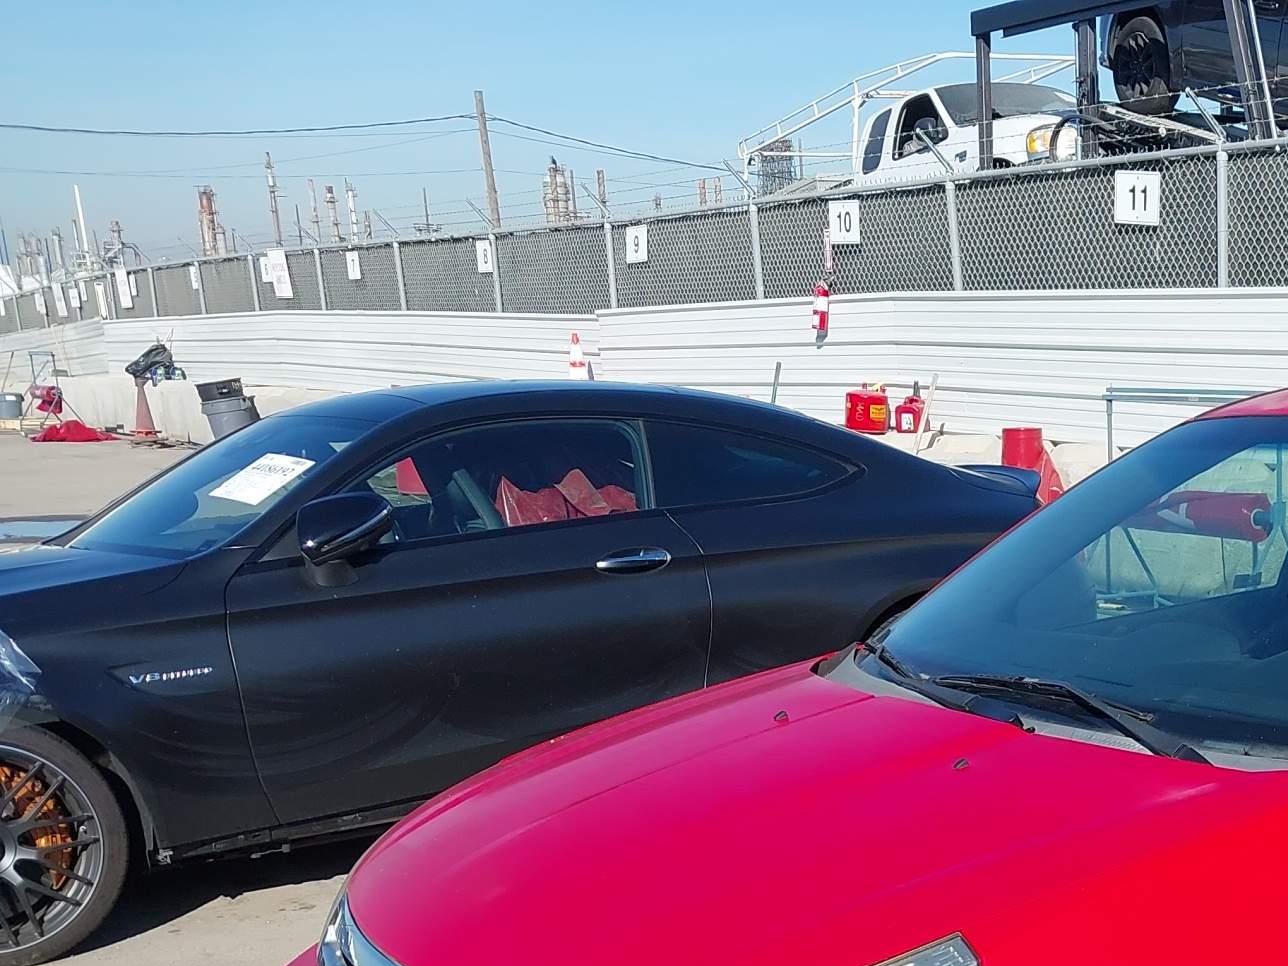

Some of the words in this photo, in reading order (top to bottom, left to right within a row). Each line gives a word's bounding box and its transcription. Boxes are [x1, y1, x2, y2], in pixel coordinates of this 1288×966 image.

[1128, 184, 1147, 211] 11
[837, 211, 851, 233] 10
[633, 235, 640, 254] 9
[482, 248, 489, 265] 8
